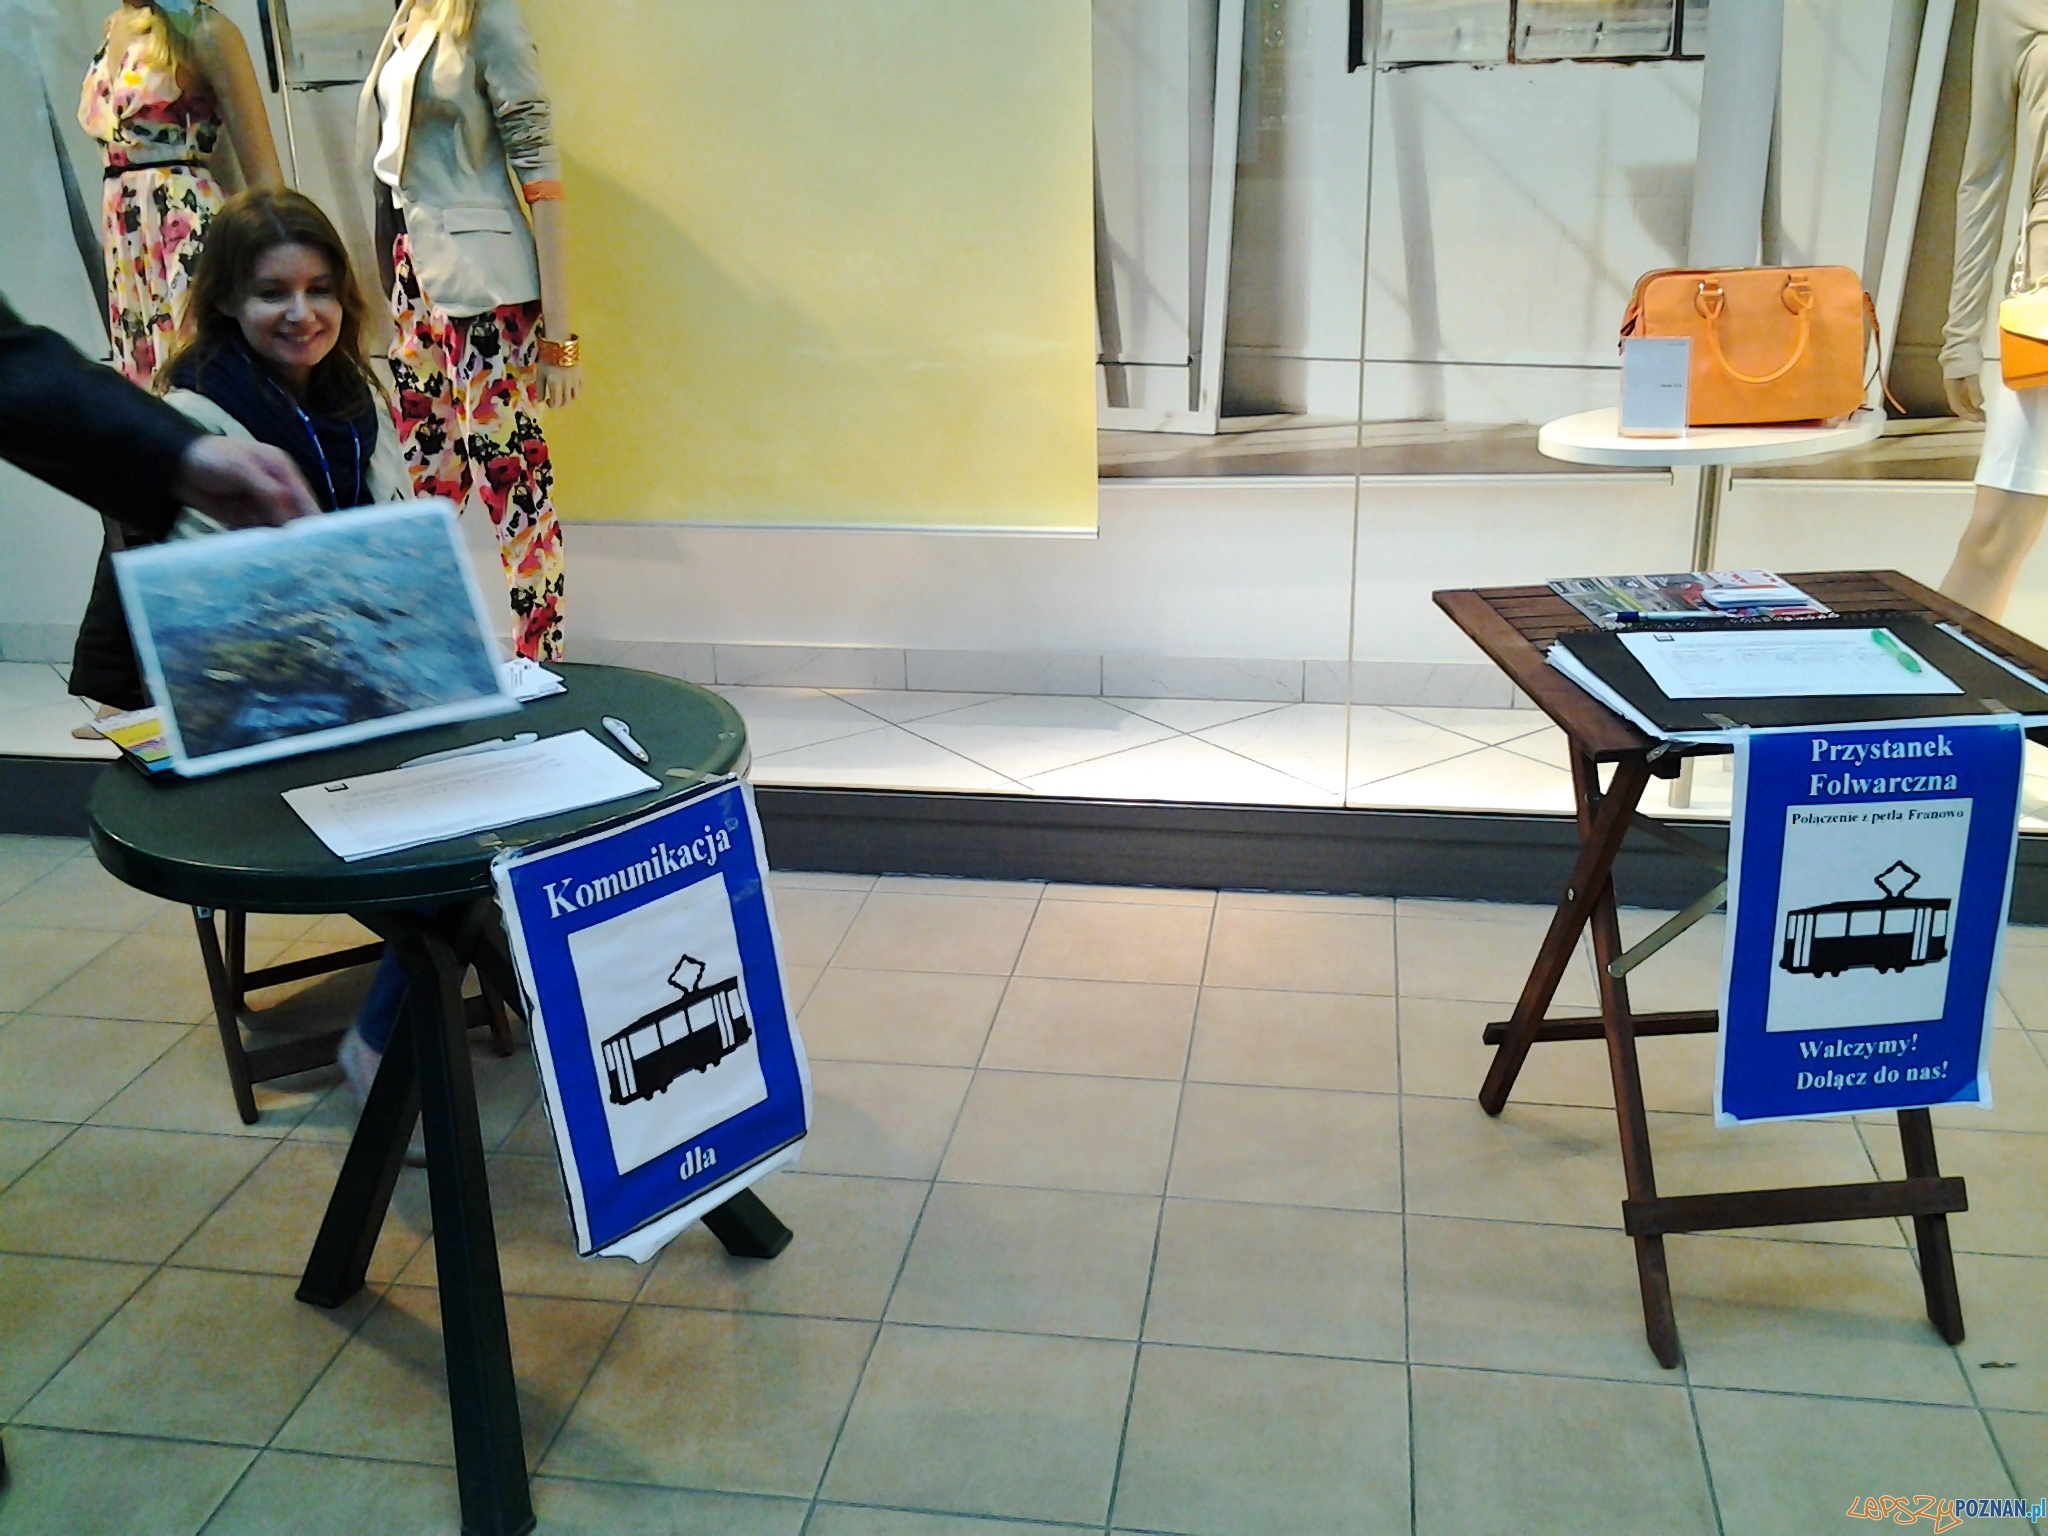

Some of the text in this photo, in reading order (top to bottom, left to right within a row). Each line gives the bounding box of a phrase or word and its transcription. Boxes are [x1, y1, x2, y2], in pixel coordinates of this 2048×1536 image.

[1811, 734, 1954, 766] Przystanek
[1808, 773, 1958, 796] Folwarczna
[1861, 813, 1868, 822] z
[1908, 808, 1964, 821] Franowo
[543, 825, 732, 919] Komunikacja
[1800, 1033, 1918, 1060] Walczymy!
[1873, 1065, 1900, 1084] do
[1906, 1060, 1948, 1082] nas!
[679, 1145, 717, 1181] dla
